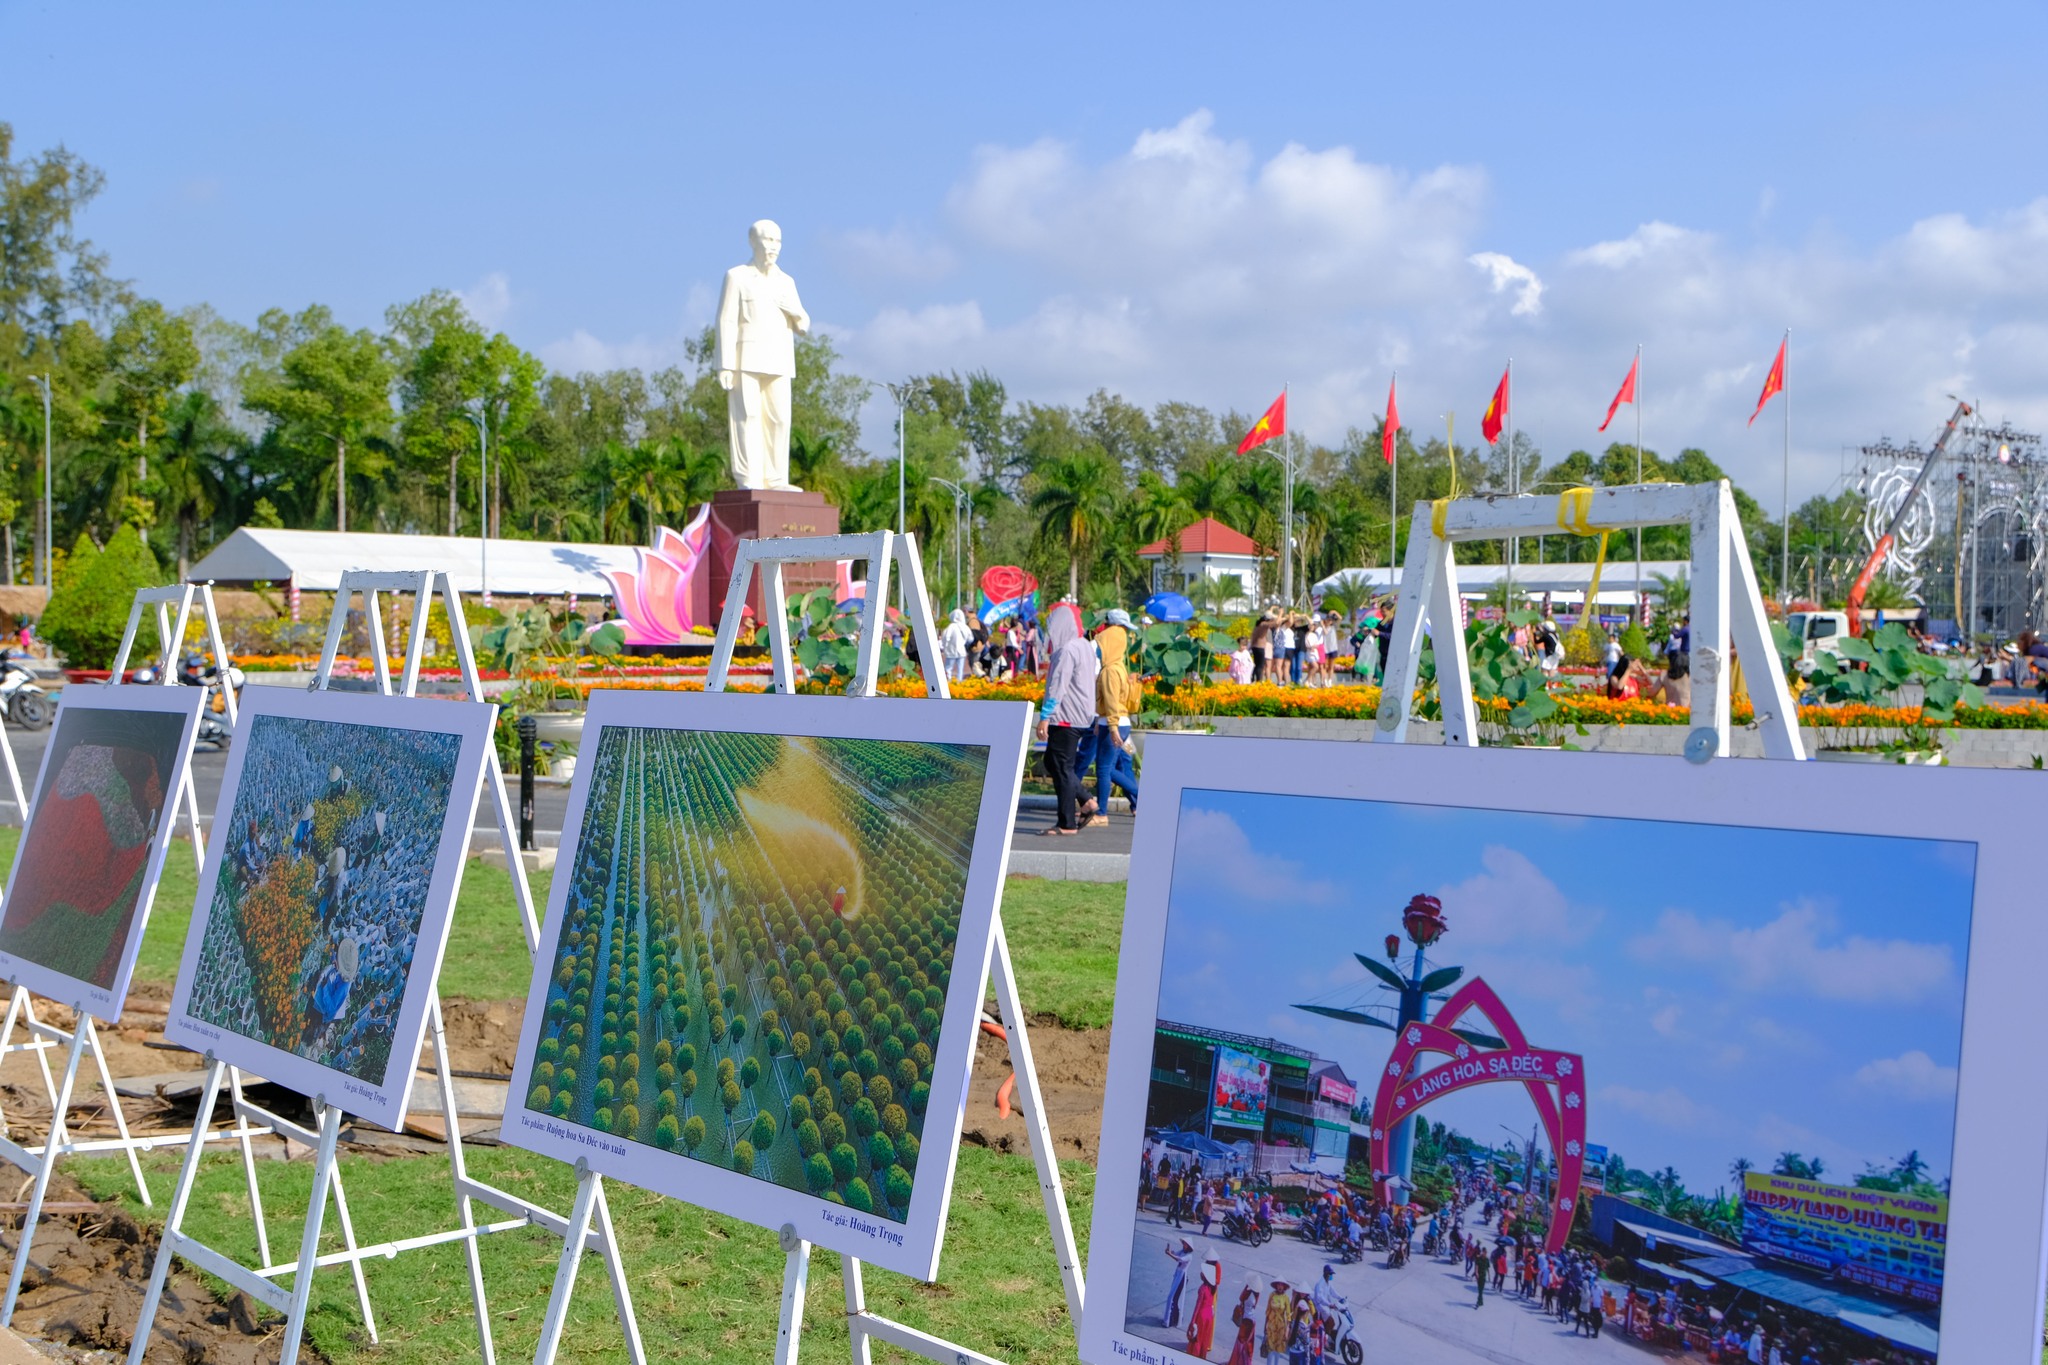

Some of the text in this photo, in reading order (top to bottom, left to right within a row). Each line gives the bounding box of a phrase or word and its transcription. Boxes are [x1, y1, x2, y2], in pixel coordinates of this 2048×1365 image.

[1412, 1071, 1452, 1101] LÀNG
[1452, 1060, 1486, 1082] HOA
[1489, 1056, 1510, 1074] SA
[546, 1122, 566, 1139] Ruộng
[566, 1128, 577, 1140] hoa
[578, 1132, 586, 1144] Sa
[586, 1135, 598, 1148] Đéc
[599, 1140, 610, 1152] vào
[610, 1144, 626, 1156] xuân
[1770, 1178, 1795, 1190] KHU
[1797, 1183, 1816, 1193] DU
[1818, 1186, 1848, 1198] LỊCH
[1850, 1192, 1888, 1206] MIỆT
[822, 1209, 904, 1246] Tác giả: Hoàng Trọng
[1747, 1188, 1803, 1212] HAPPY
[1804, 1199, 1852, 1222] LAND
[1854, 1207, 1916, 1238] HÙNG
[1112, 1340, 1128, 1356] Tác
[1130, 1346, 1158, 1365] phẩm:
